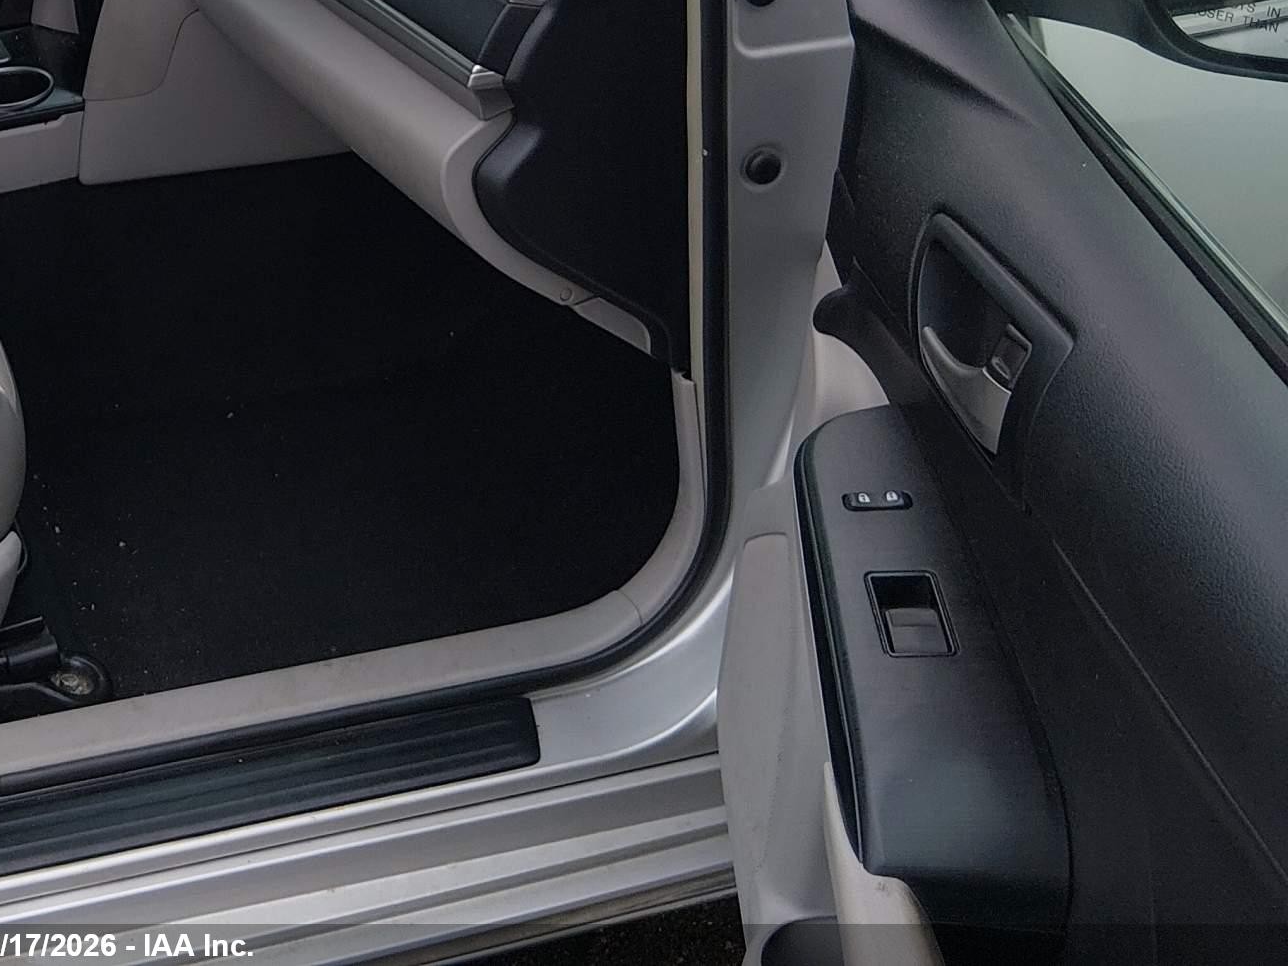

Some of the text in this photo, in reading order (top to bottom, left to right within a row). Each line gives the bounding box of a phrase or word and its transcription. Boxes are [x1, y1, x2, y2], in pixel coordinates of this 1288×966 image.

[1194, 9, 1280, 33] OSER THAN
[1266, 5, 1282, 19] IN
